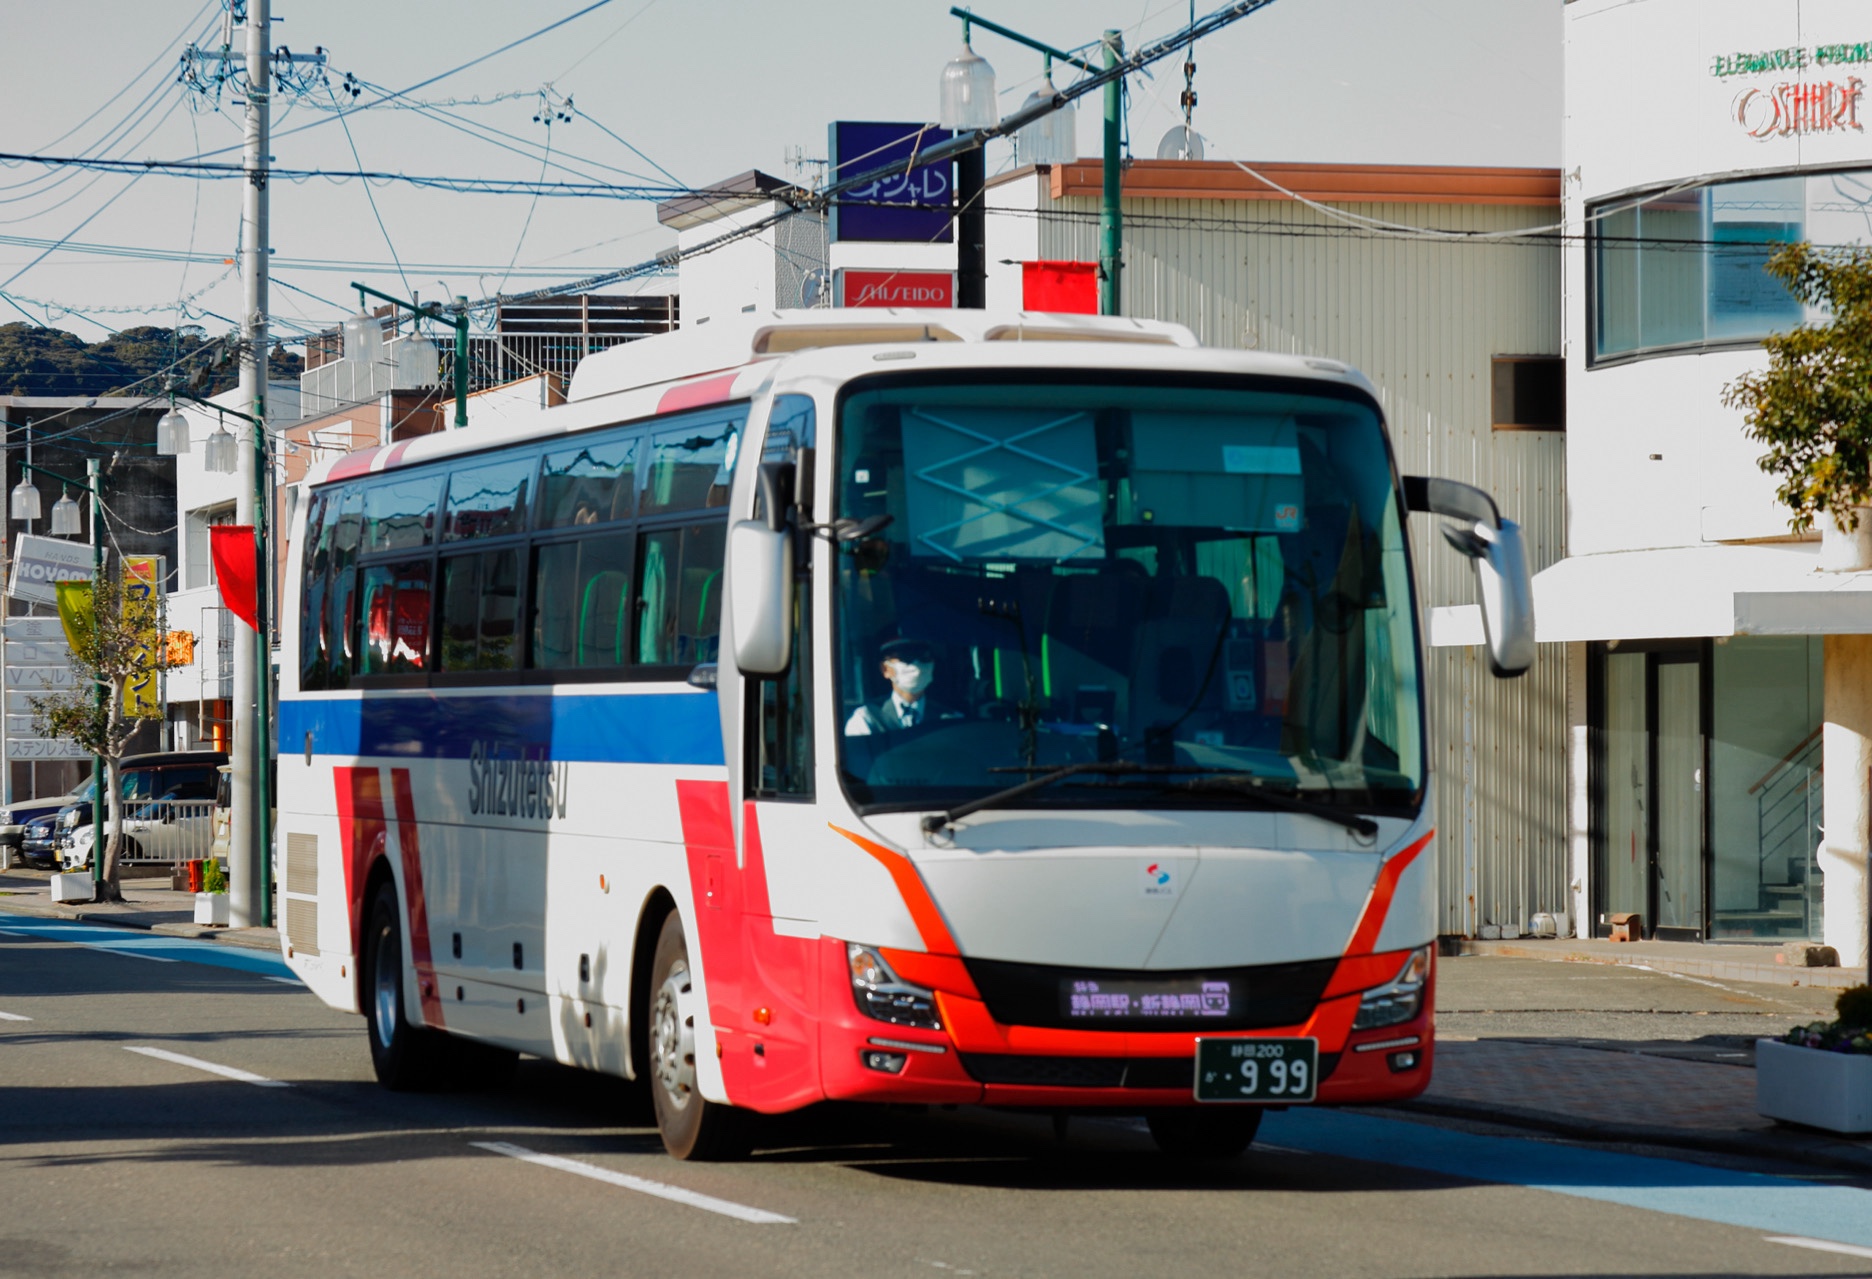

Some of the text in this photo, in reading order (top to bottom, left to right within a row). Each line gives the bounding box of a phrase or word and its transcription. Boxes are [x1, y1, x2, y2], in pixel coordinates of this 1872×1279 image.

[852, 284, 944, 302] SHISEIDO
[44, 551, 80, 563] HANDS
[18, 561, 93, 581] KOYAM
[11, 741, 92, 756] ステンレス金
[468, 739, 568, 820] Shizutetsu
